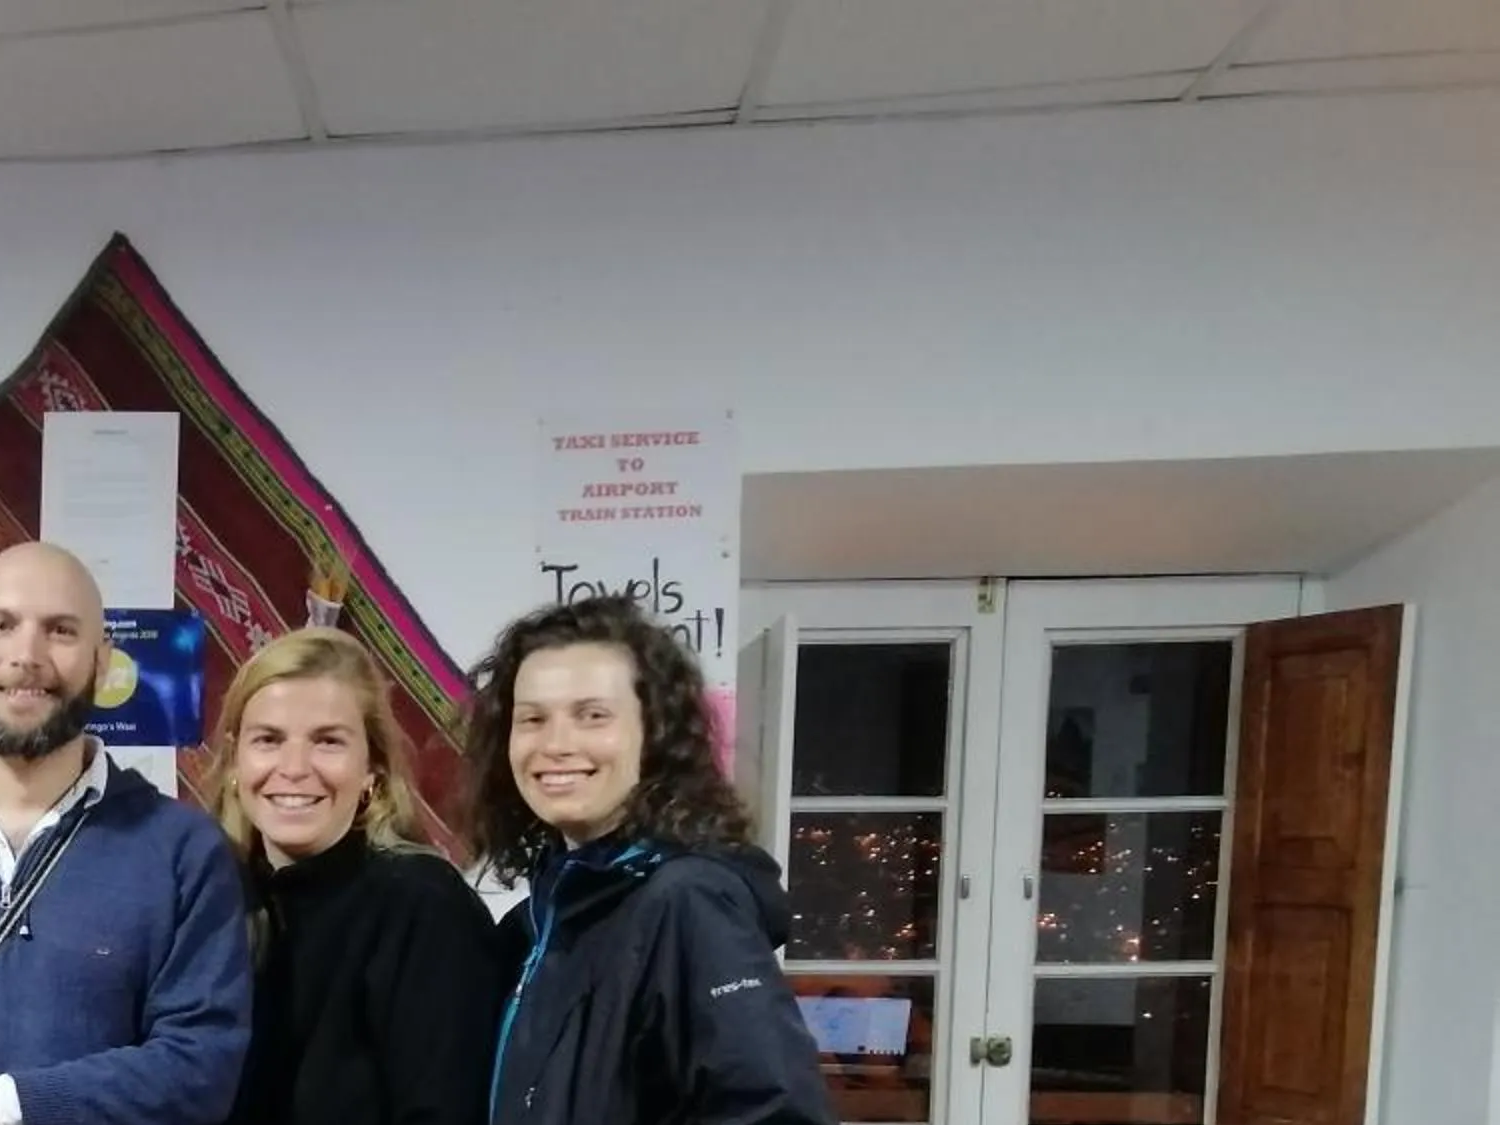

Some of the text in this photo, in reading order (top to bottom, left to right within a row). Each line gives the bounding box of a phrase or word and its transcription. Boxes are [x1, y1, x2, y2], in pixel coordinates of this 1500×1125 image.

[553, 431, 700, 450] TAXI SERVICE
[617, 458, 644, 472] TO
[582, 481, 678, 498] AIRPORT
[557, 505, 702, 522] TRAIN STATION
